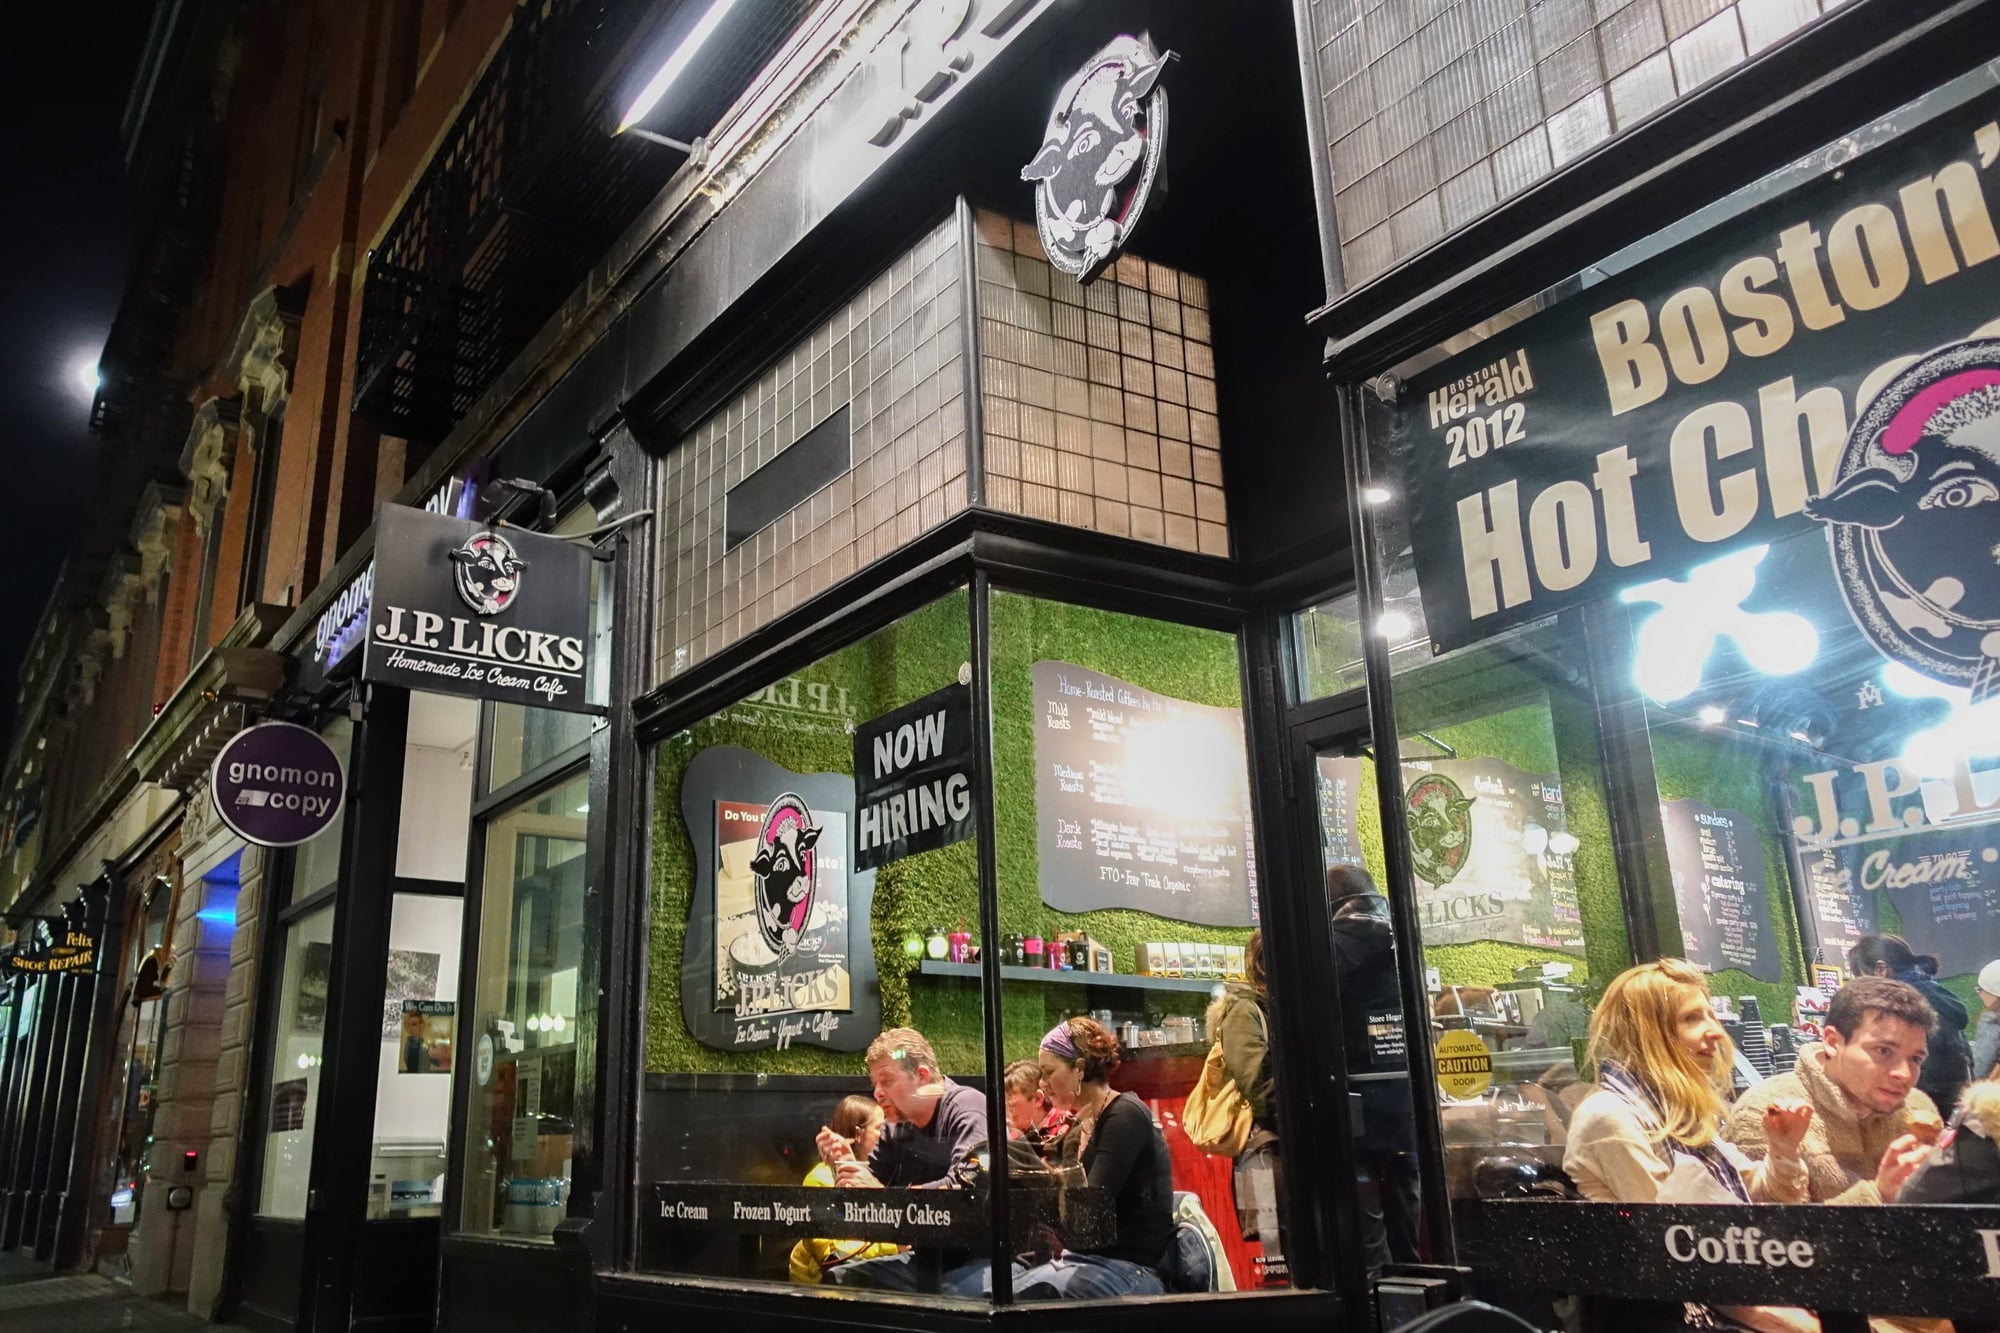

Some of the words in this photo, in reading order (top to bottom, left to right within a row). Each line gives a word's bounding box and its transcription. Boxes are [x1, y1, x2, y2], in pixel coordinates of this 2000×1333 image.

[1428, 348, 1534, 430] Herald
[1449, 363, 1499, 395] BOSTON
[1445, 402, 1526, 469] 2012
[1457, 445, 1651, 620] Hot
[375, 606, 444, 648] J.P.
[448, 617, 585, 671] LICKS
[386, 649, 460, 678] Homemade
[461, 663, 484, 680] Ice
[487, 668, 530, 690] Cream
[533, 678, 568, 702] Cafe
[874, 709, 946, 780] NOW
[229, 762, 335, 788] gnomon
[269, 792, 331, 818] copy
[725, 810, 739, 820] Do
[741, 812, 759, 821] You
[860, 773, 970, 851] HIRING
[1057, 818, 1081, 835] Dark
[1861, 850, 1967, 890] Cream
[1426, 891, 1504, 924] LICKS
[66, 931, 93, 948] Felix
[12, 955, 46, 971] SHOE
[48, 950, 93, 971] REPAIR
[767, 967, 840, 1012] LICKS
[418, 1002, 434, 1012] Can
[434, 1003, 446, 1012] Do
[734, 1025, 747, 1044] Ice
[747, 1023, 770, 1042] Cream
[777, 1018, 804, 1051] Yogurt
[812, 1011, 840, 1041] Coffee
[1438, 1057, 1489, 1073] CAUTION
[1439, 1043, 1482, 1055] AUTOMATIC
[1453, 1077, 1476, 1087] DOOR
[661, 1200, 675, 1218] Ice
[676, 1201, 708, 1220] Cream
[733, 1201, 771, 1221] Frozen
[773, 1202, 812, 1226] Yogurt
[844, 1202, 903, 1229] Birthday
[905, 1203, 951, 1226] Cakes
[1664, 1225, 1815, 1268] Coffee
